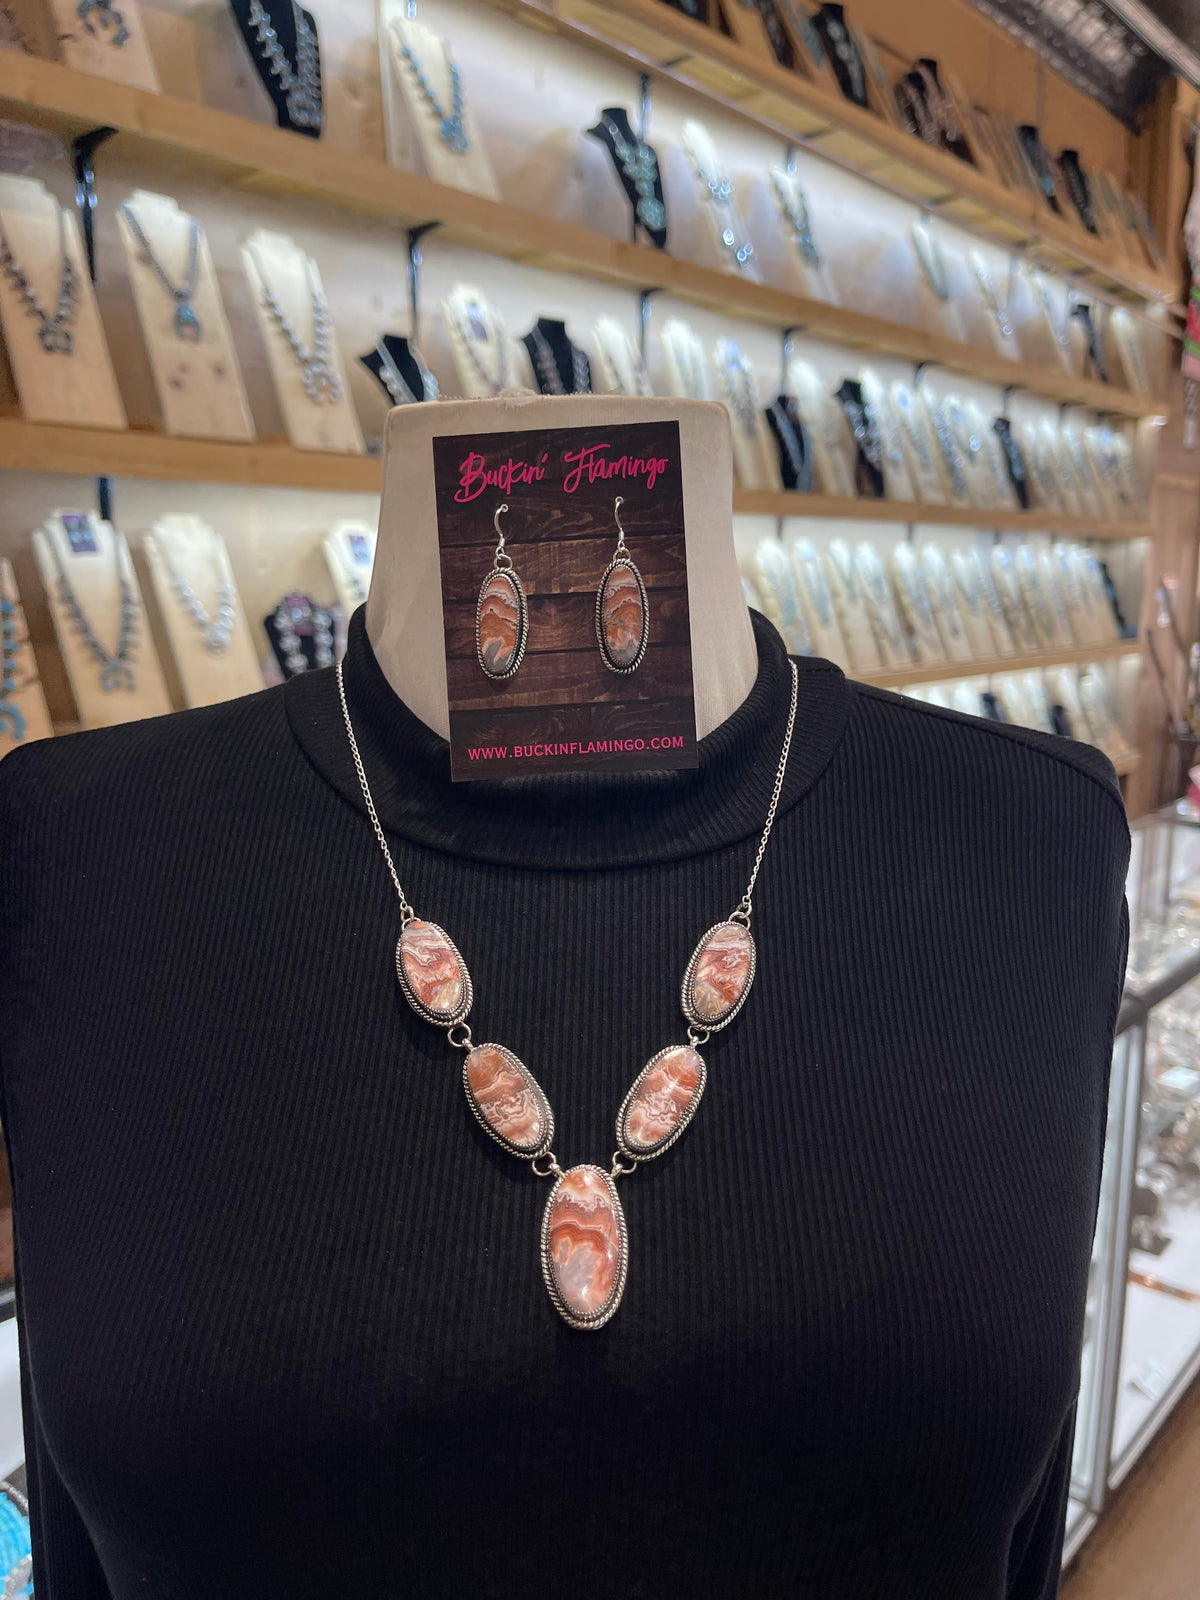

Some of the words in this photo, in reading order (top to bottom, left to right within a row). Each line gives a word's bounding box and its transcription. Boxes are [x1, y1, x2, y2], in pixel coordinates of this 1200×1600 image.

[454, 452, 549, 503] Buckin'
[563, 443, 669, 493] Flamingo
[467, 735, 684, 760] WWW.BUCKINFLAMINGO.COM
